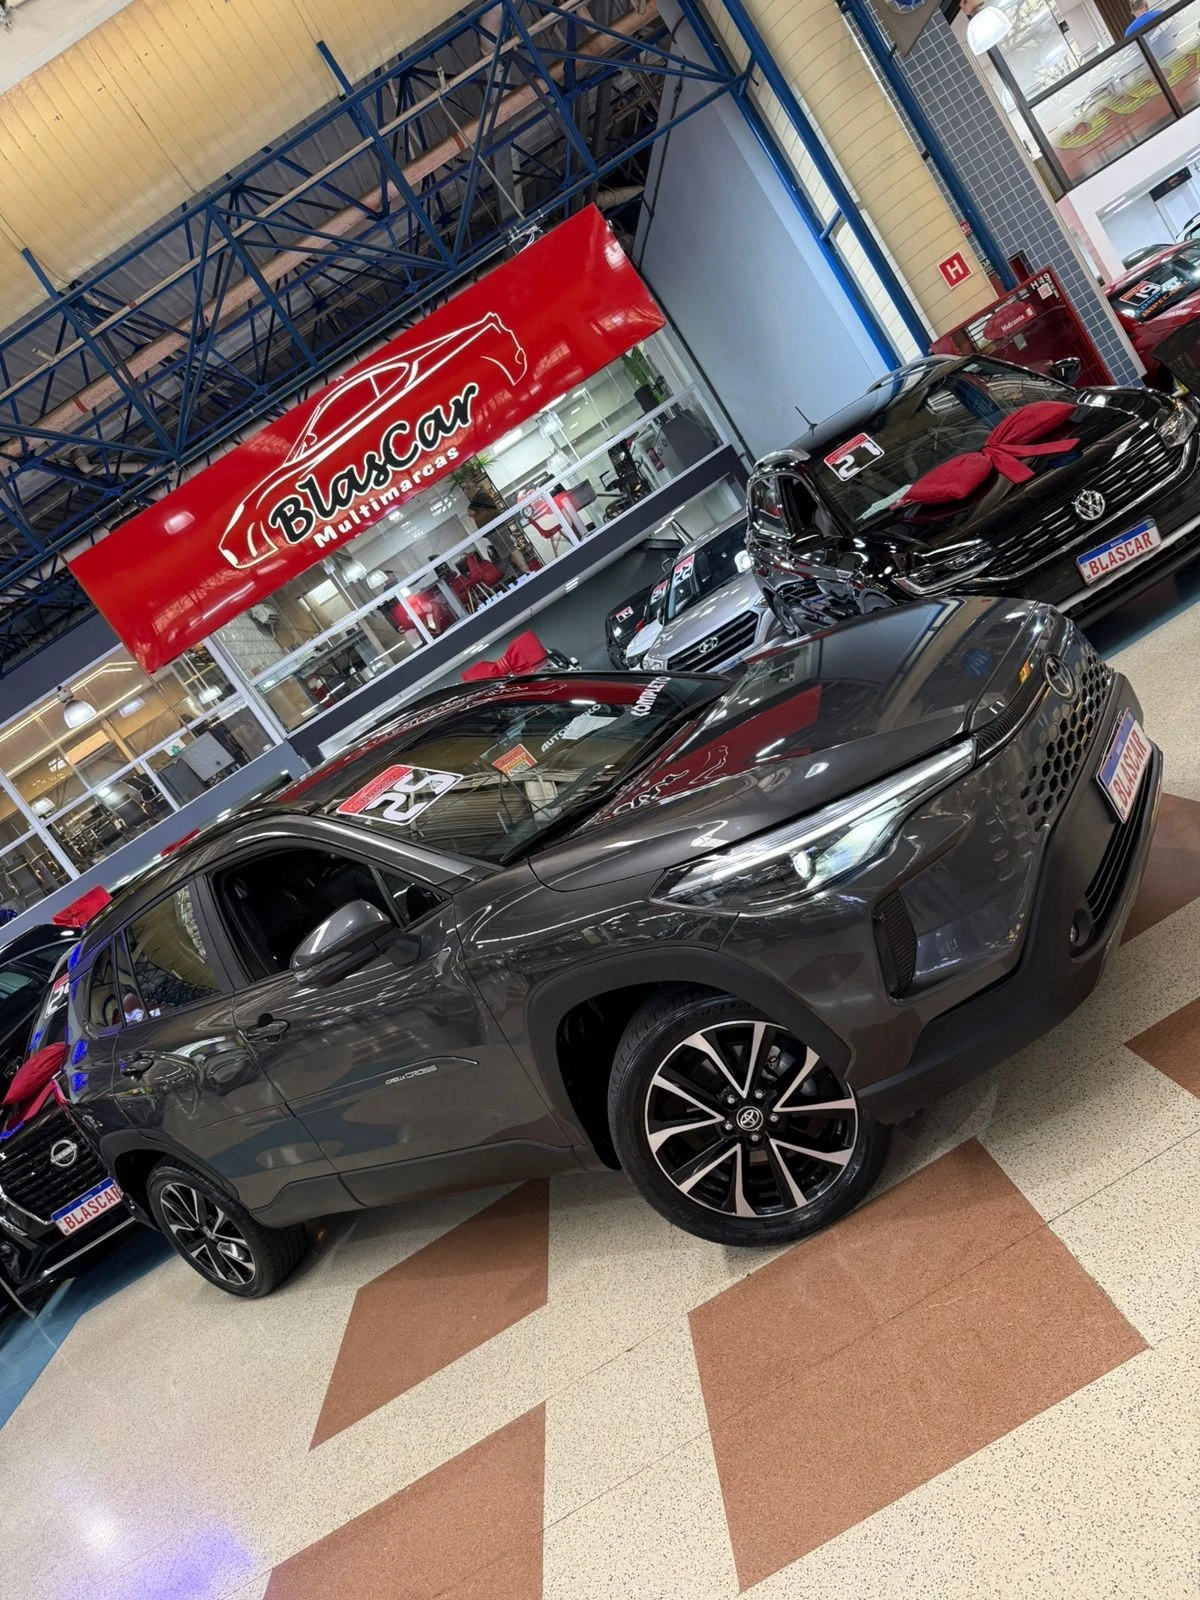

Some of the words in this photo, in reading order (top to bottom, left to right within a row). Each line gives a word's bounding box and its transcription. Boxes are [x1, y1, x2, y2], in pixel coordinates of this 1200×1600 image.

[947, 259, 964, 280] H
[1135, 285, 1161, 299] 19
[1001, 314, 1025, 332] Hidrante
[268, 382, 478, 545] BlasCar
[834, 441, 881, 478] 21
[313, 446, 460, 548] Multimarcas
[1088, 531, 1153, 576] BLASCAR
[630, 676, 672, 717] COMPLETO
[1113, 729, 1147, 808] BLASCAR
